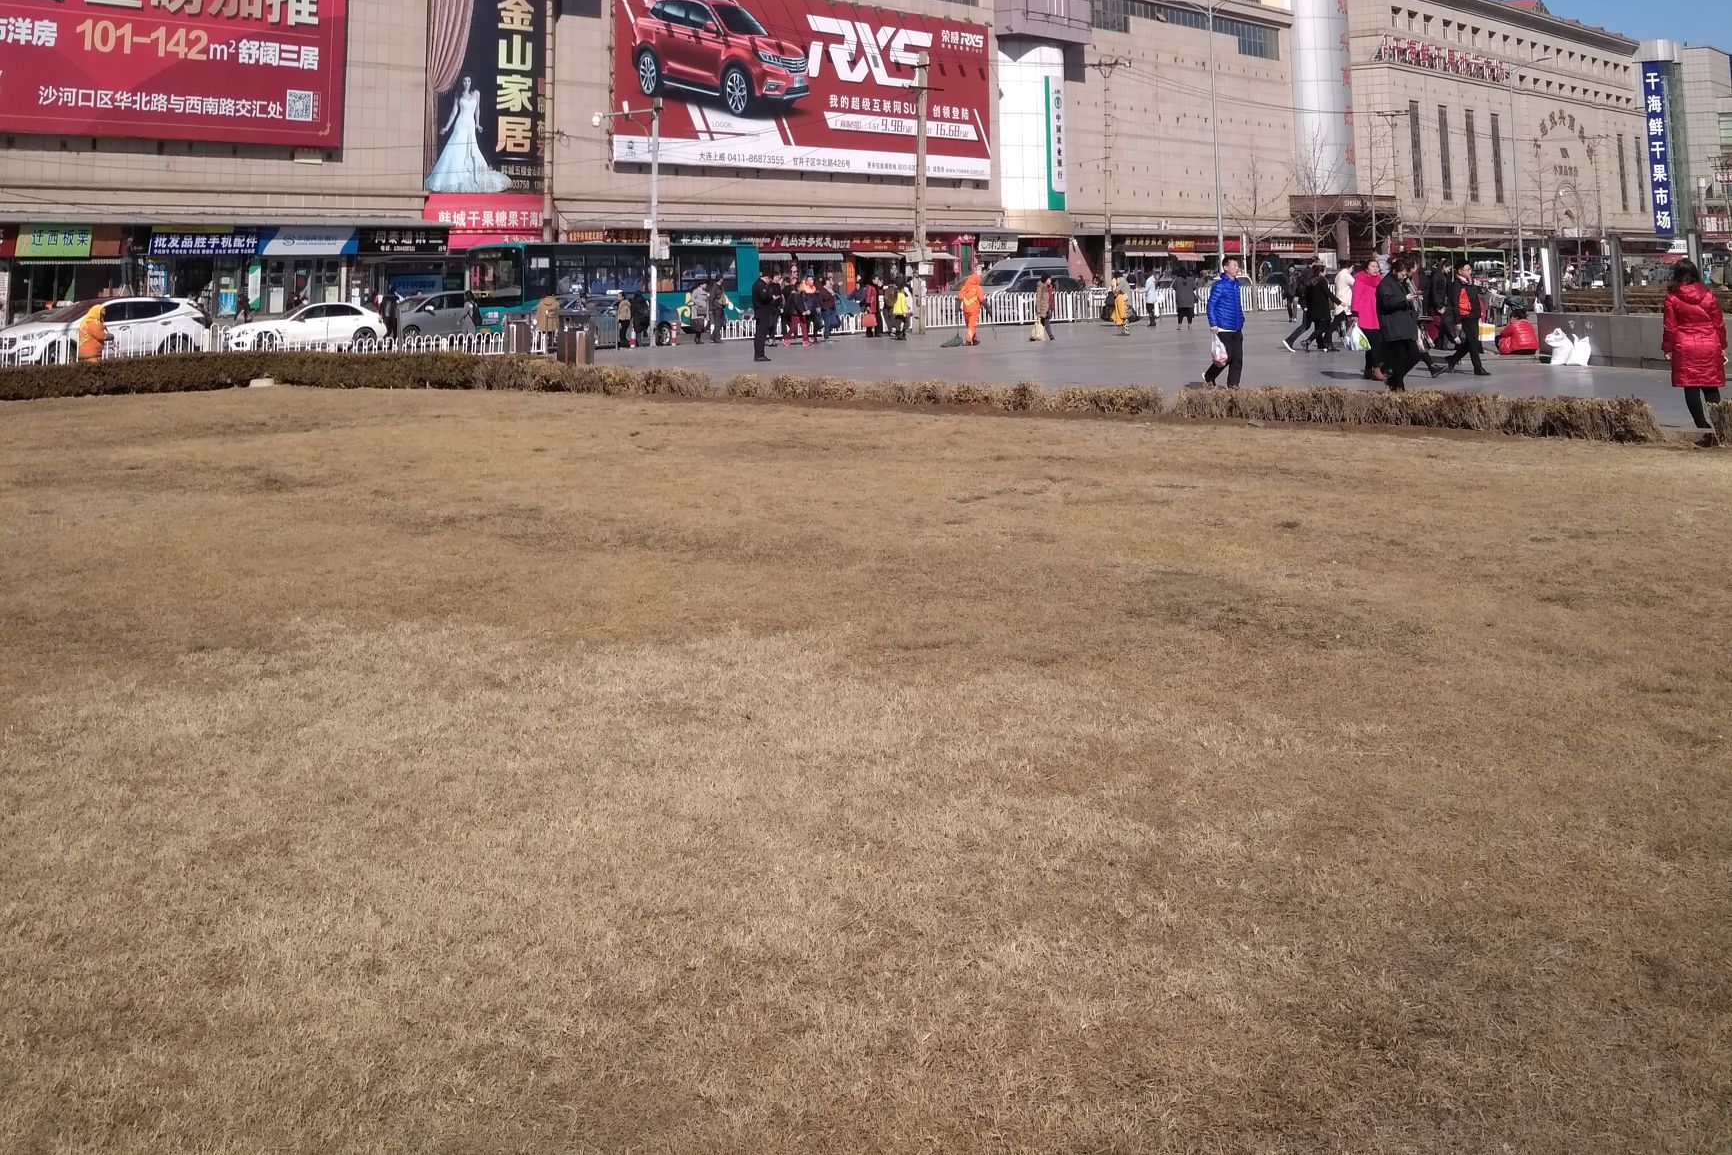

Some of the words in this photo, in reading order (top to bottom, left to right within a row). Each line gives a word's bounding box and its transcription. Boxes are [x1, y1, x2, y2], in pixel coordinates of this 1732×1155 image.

[238, 38, 320, 71] 舒阔三居
[38, 85, 284, 119] 沙河口区华北路与西南路交汇处
[829, 94, 918, 116] 我的超级互联网SU
[1645, 72, 1672, 230] 干海鲜干果市场
[31, 228, 90, 247] 迁西板栗
[153, 233, 258, 249] 批发品胜手机配件
